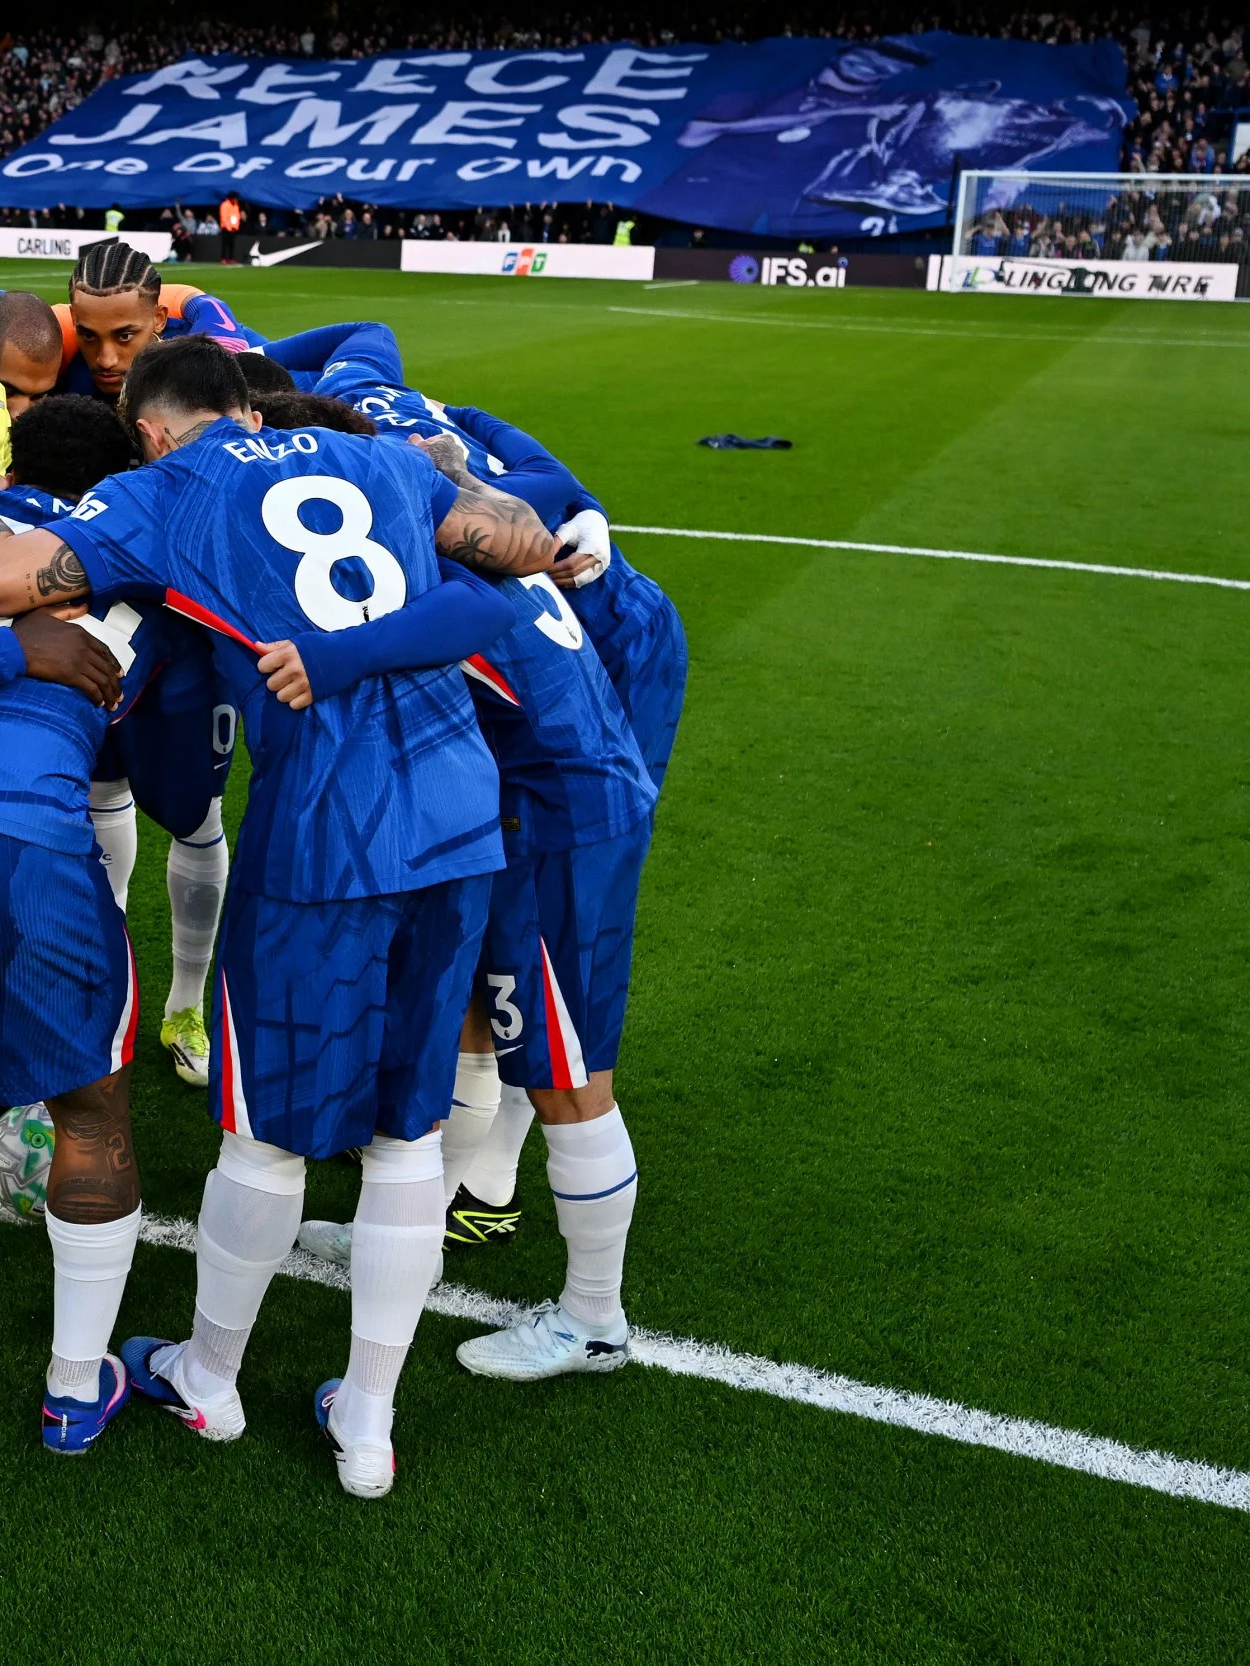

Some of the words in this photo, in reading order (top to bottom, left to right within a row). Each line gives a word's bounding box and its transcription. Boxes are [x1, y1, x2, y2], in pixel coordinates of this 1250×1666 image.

[122, 49, 708, 104] REECE
[48, 98, 660, 149] JAMES
[2, 153, 148, 178] One
[173, 152, 274, 179] Of
[456, 154, 643, 184] own
[17, 238, 71, 255] CARLING
[502, 248, 547, 275] FPT
[761, 256, 848, 288] IFS.ai
[222, 433, 319, 464] ENZO
[261, 475, 407, 632] 8
[486, 973, 524, 1041] 3
